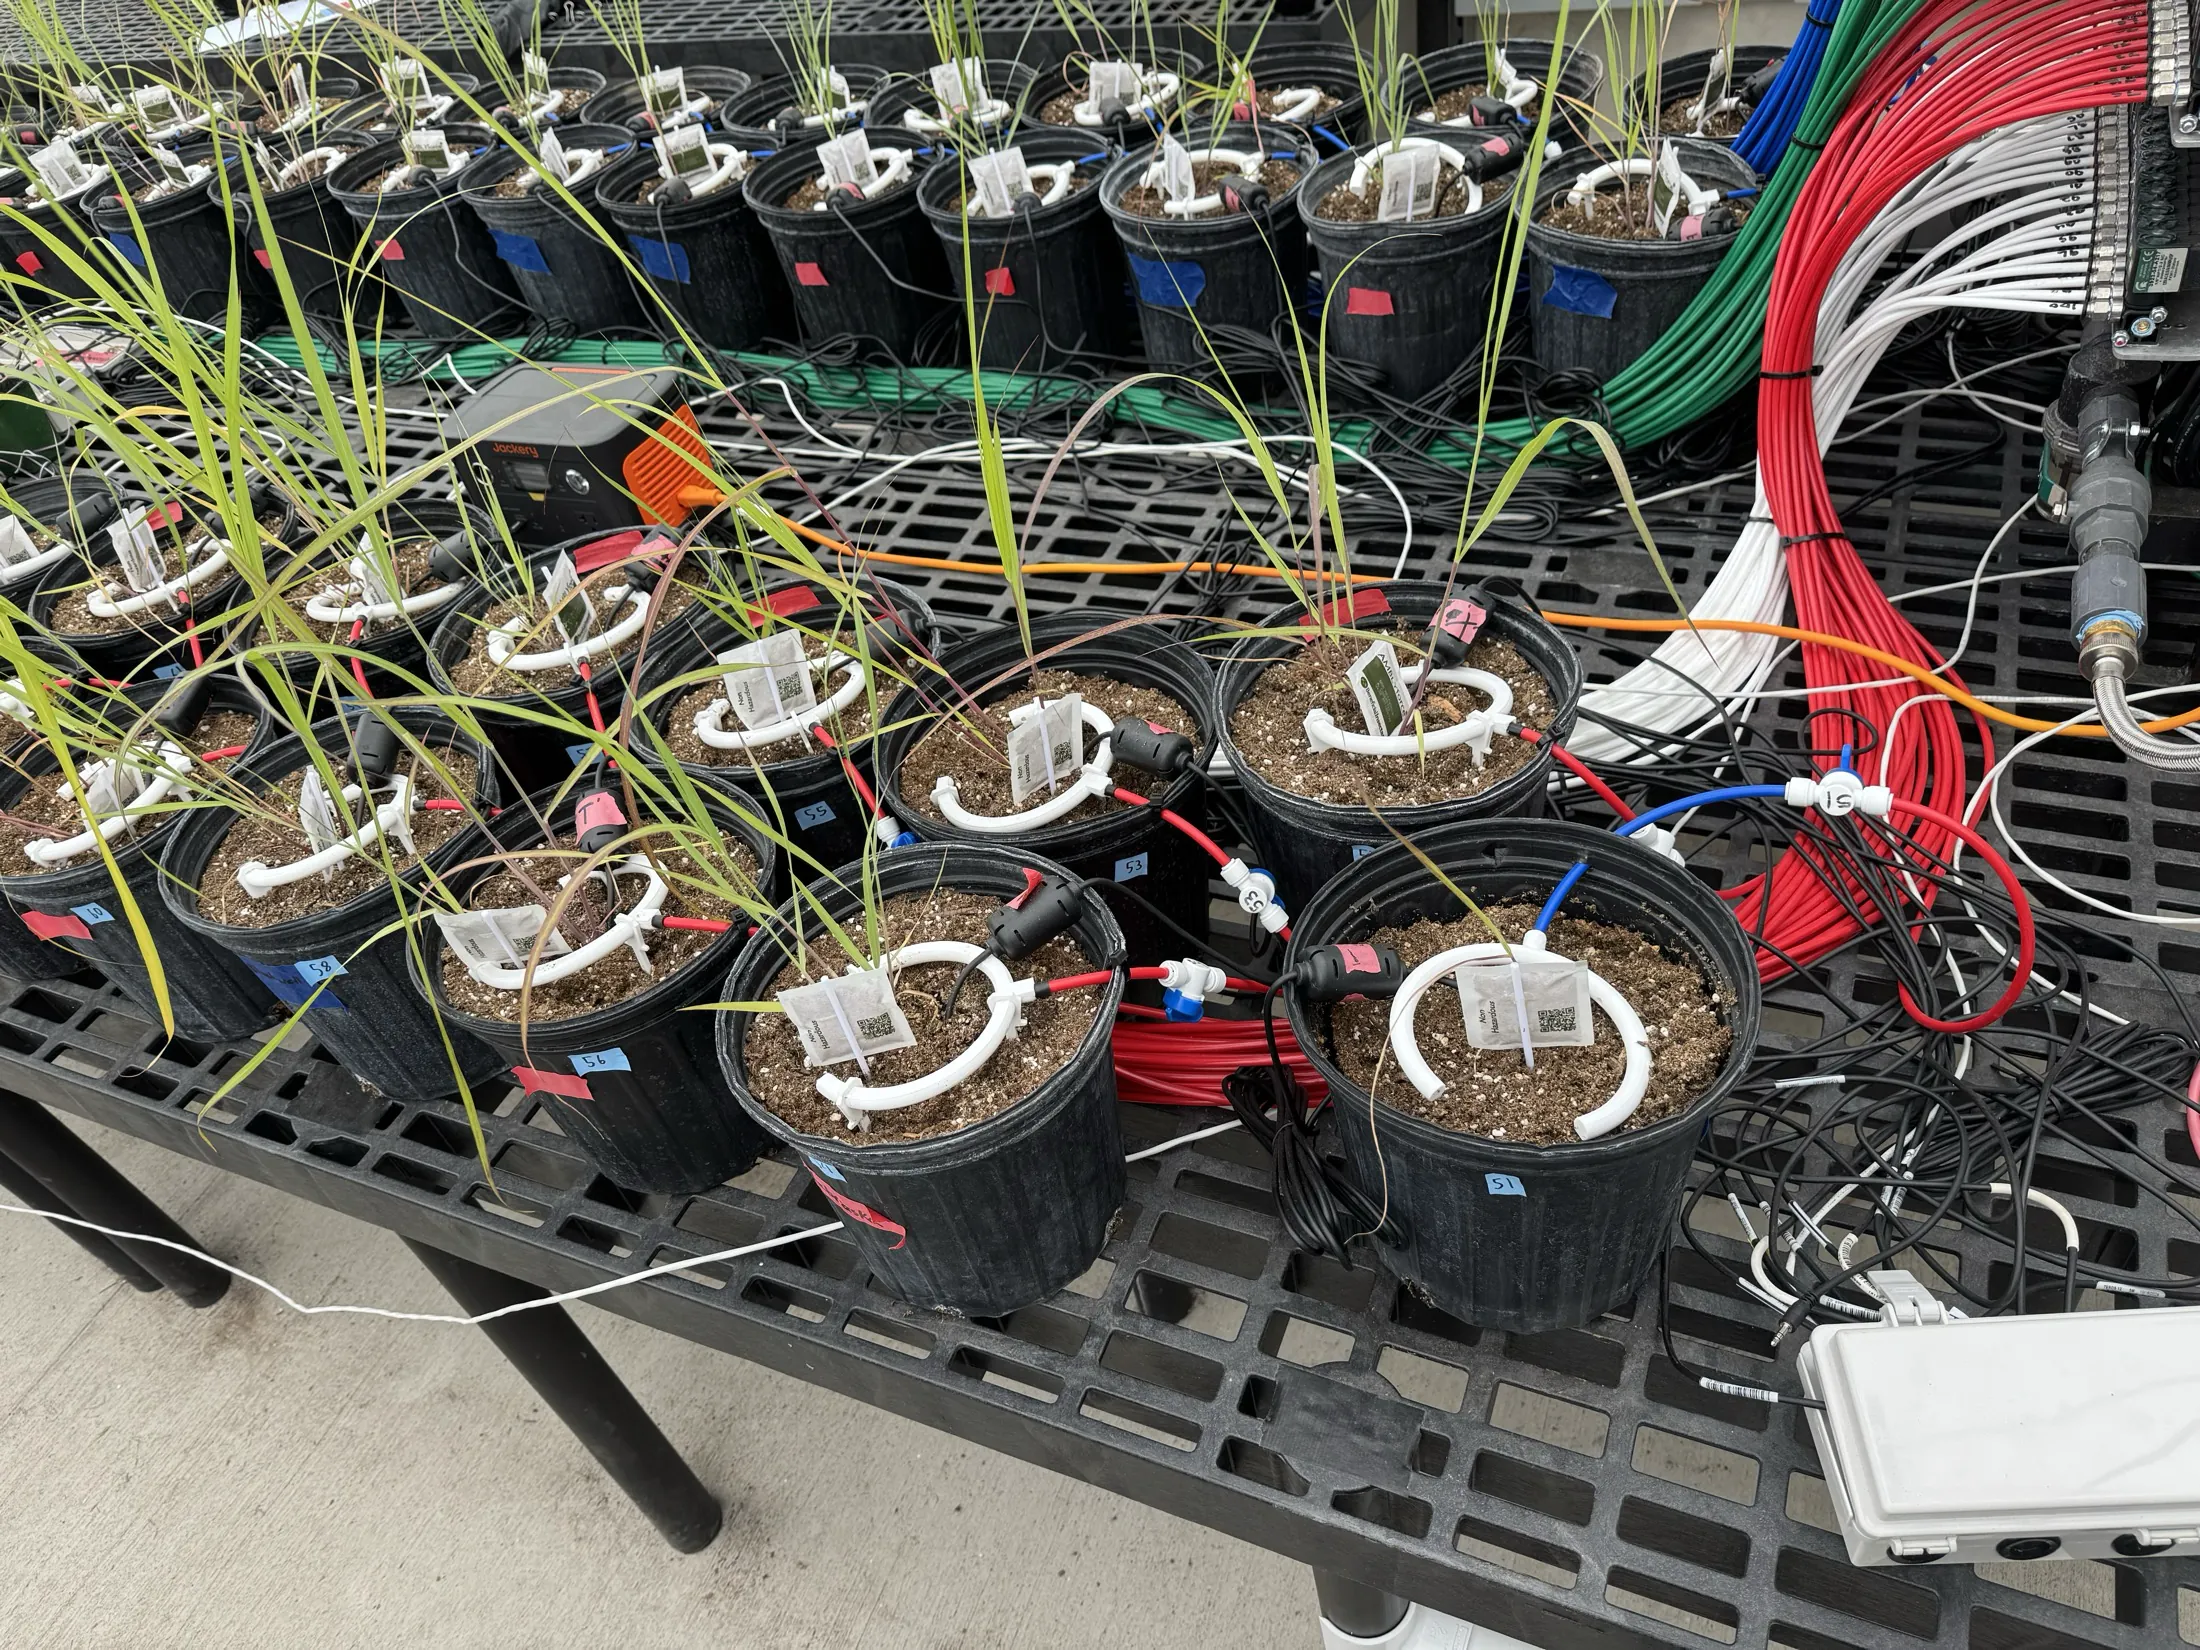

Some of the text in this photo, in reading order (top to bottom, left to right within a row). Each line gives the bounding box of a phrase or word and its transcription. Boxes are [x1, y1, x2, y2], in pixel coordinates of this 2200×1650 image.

[492, 442, 540, 459] Jackery
[743, 681, 755, 713] Hazardous
[1024, 754, 1032, 783] Hazardous
[804, 806, 827, 821] 55
[1125, 860, 1143, 874] 53
[1243, 890, 1265, 913] 53
[87, 907, 103, 919] 60
[309, 960, 332, 977] 58
[1479, 1009, 1487, 1024] Non
[1490, 1000, 1500, 1034] Hazardous
[807, 1029, 817, 1043] Non
[812, 1020, 831, 1050] Hazardous
[581, 1054, 606, 1068] 56
[1492, 1177, 1514, 1190] 51
